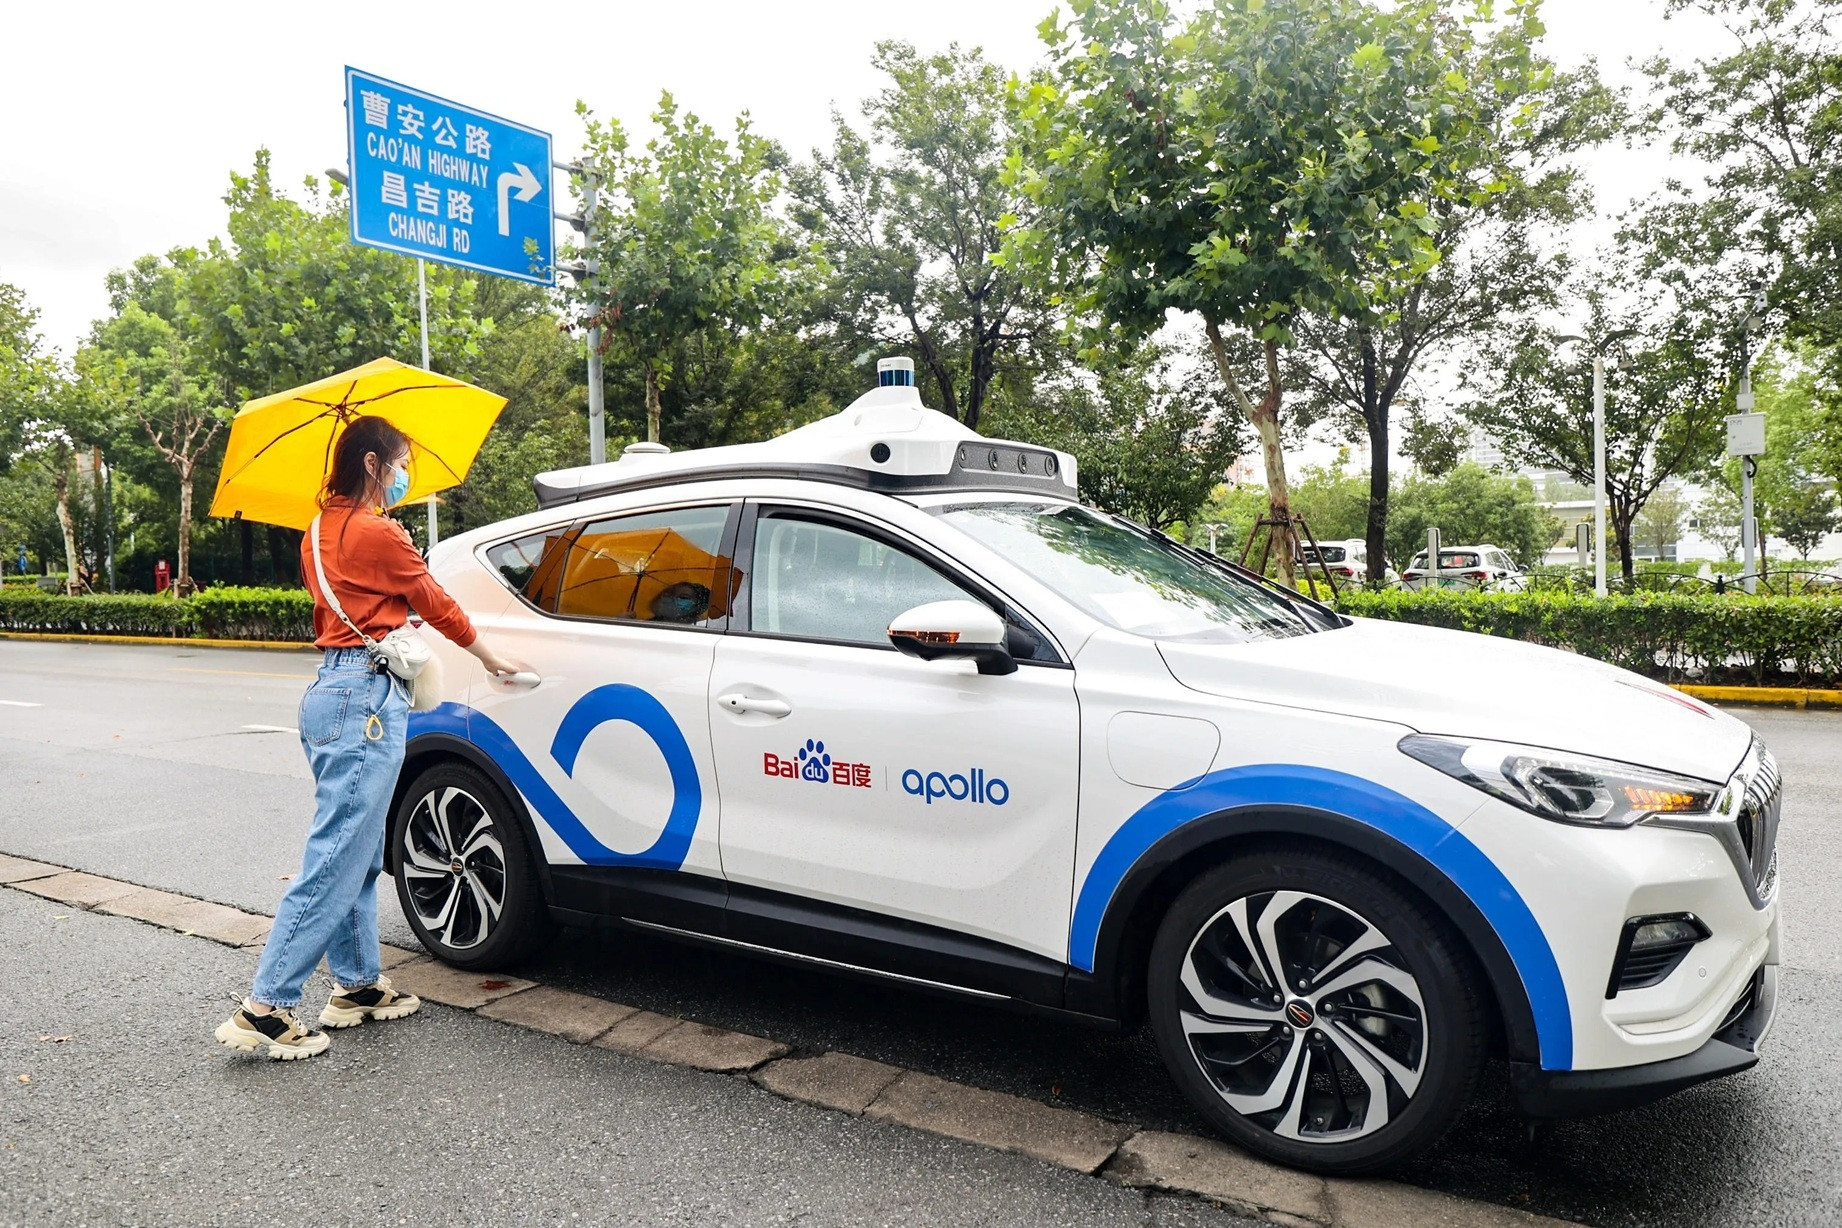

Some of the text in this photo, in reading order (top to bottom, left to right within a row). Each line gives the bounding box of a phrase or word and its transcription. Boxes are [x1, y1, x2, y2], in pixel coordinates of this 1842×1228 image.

[360, 90, 492, 160] 曹安公路
[367, 132, 489, 189] CAO'AN HIGHWAY
[381, 170, 475, 225] 昌吉路
[388, 212, 471, 254] CHANGJI RD
[901, 767, 1010, 806] apollo
